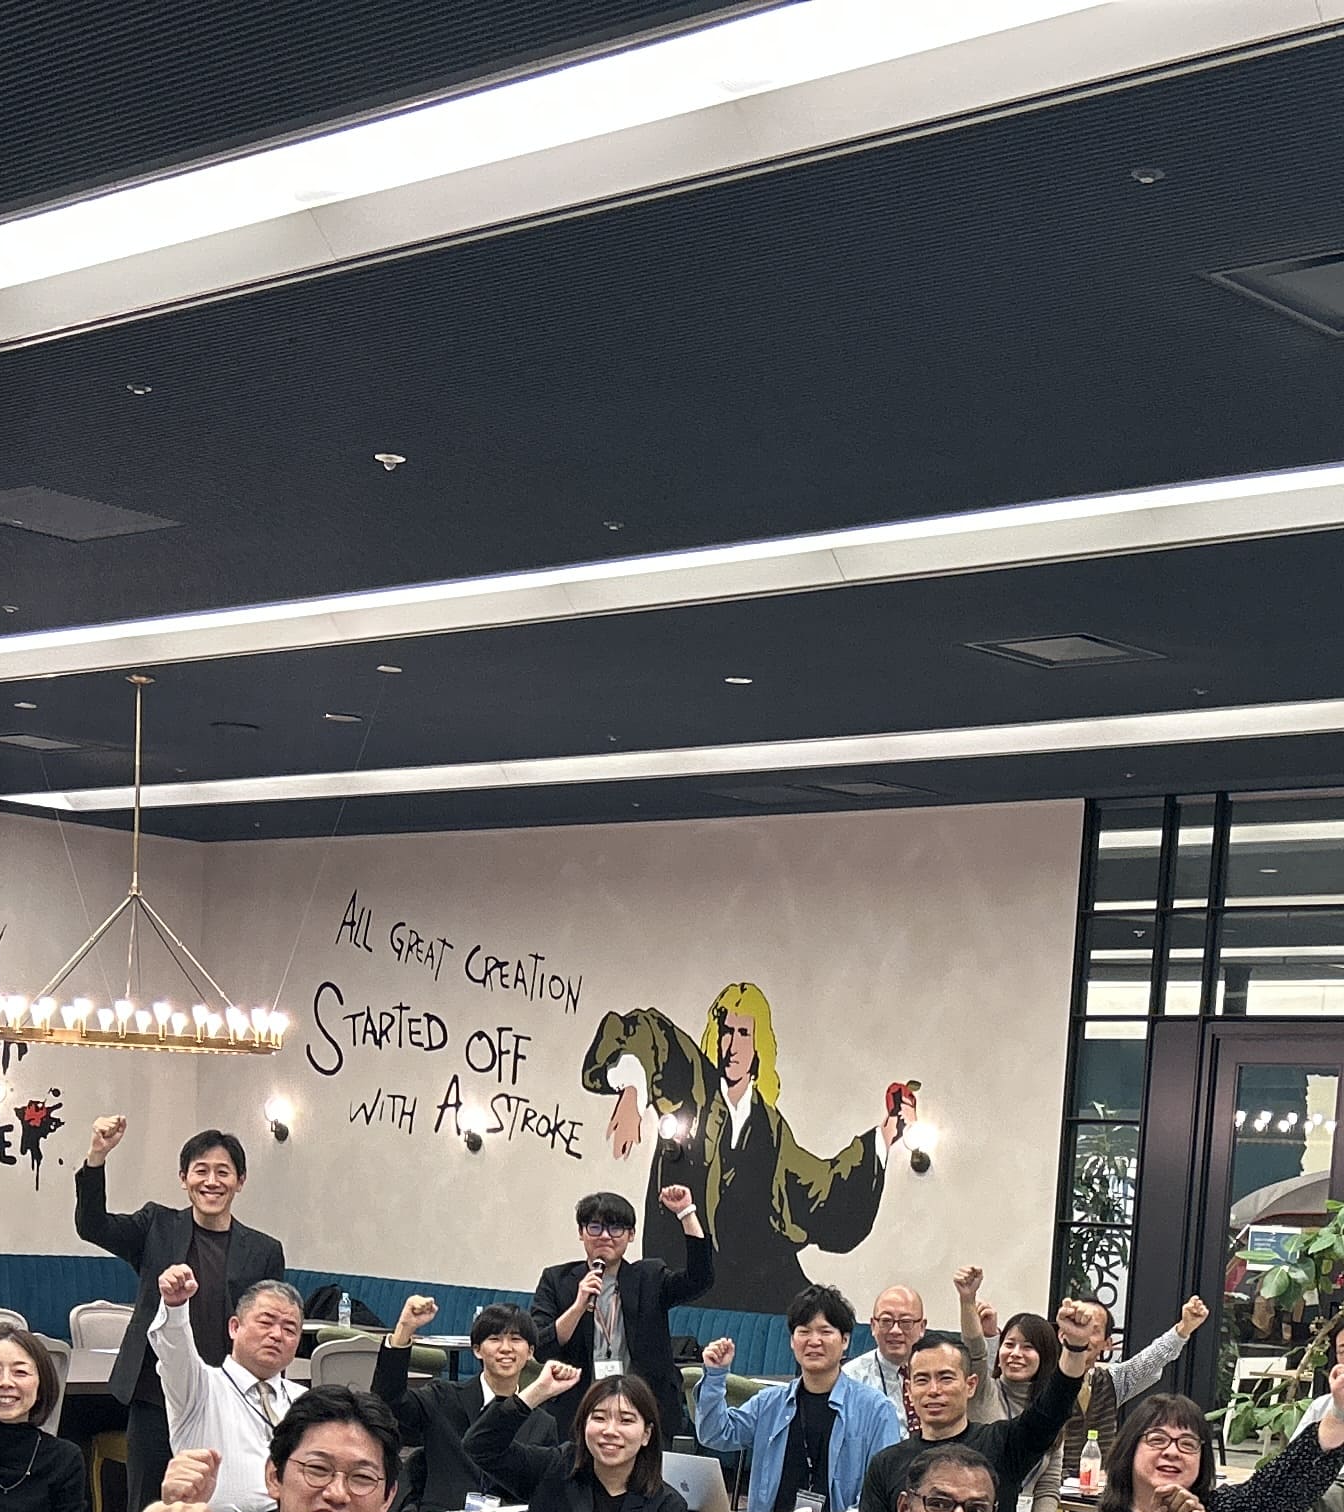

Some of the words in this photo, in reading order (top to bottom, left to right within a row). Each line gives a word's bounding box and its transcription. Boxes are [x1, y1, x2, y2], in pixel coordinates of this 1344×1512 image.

[390, 922, 453, 981] GREAT
[465, 945, 583, 1015] CREATION
[306, 981, 448, 1076] STARTED
[465, 1027, 532, 1085] OFF
[349, 1088, 417, 1134] WITH
[434, 1074, 463, 1136] A
[486, 1093, 584, 1160] STROKE
